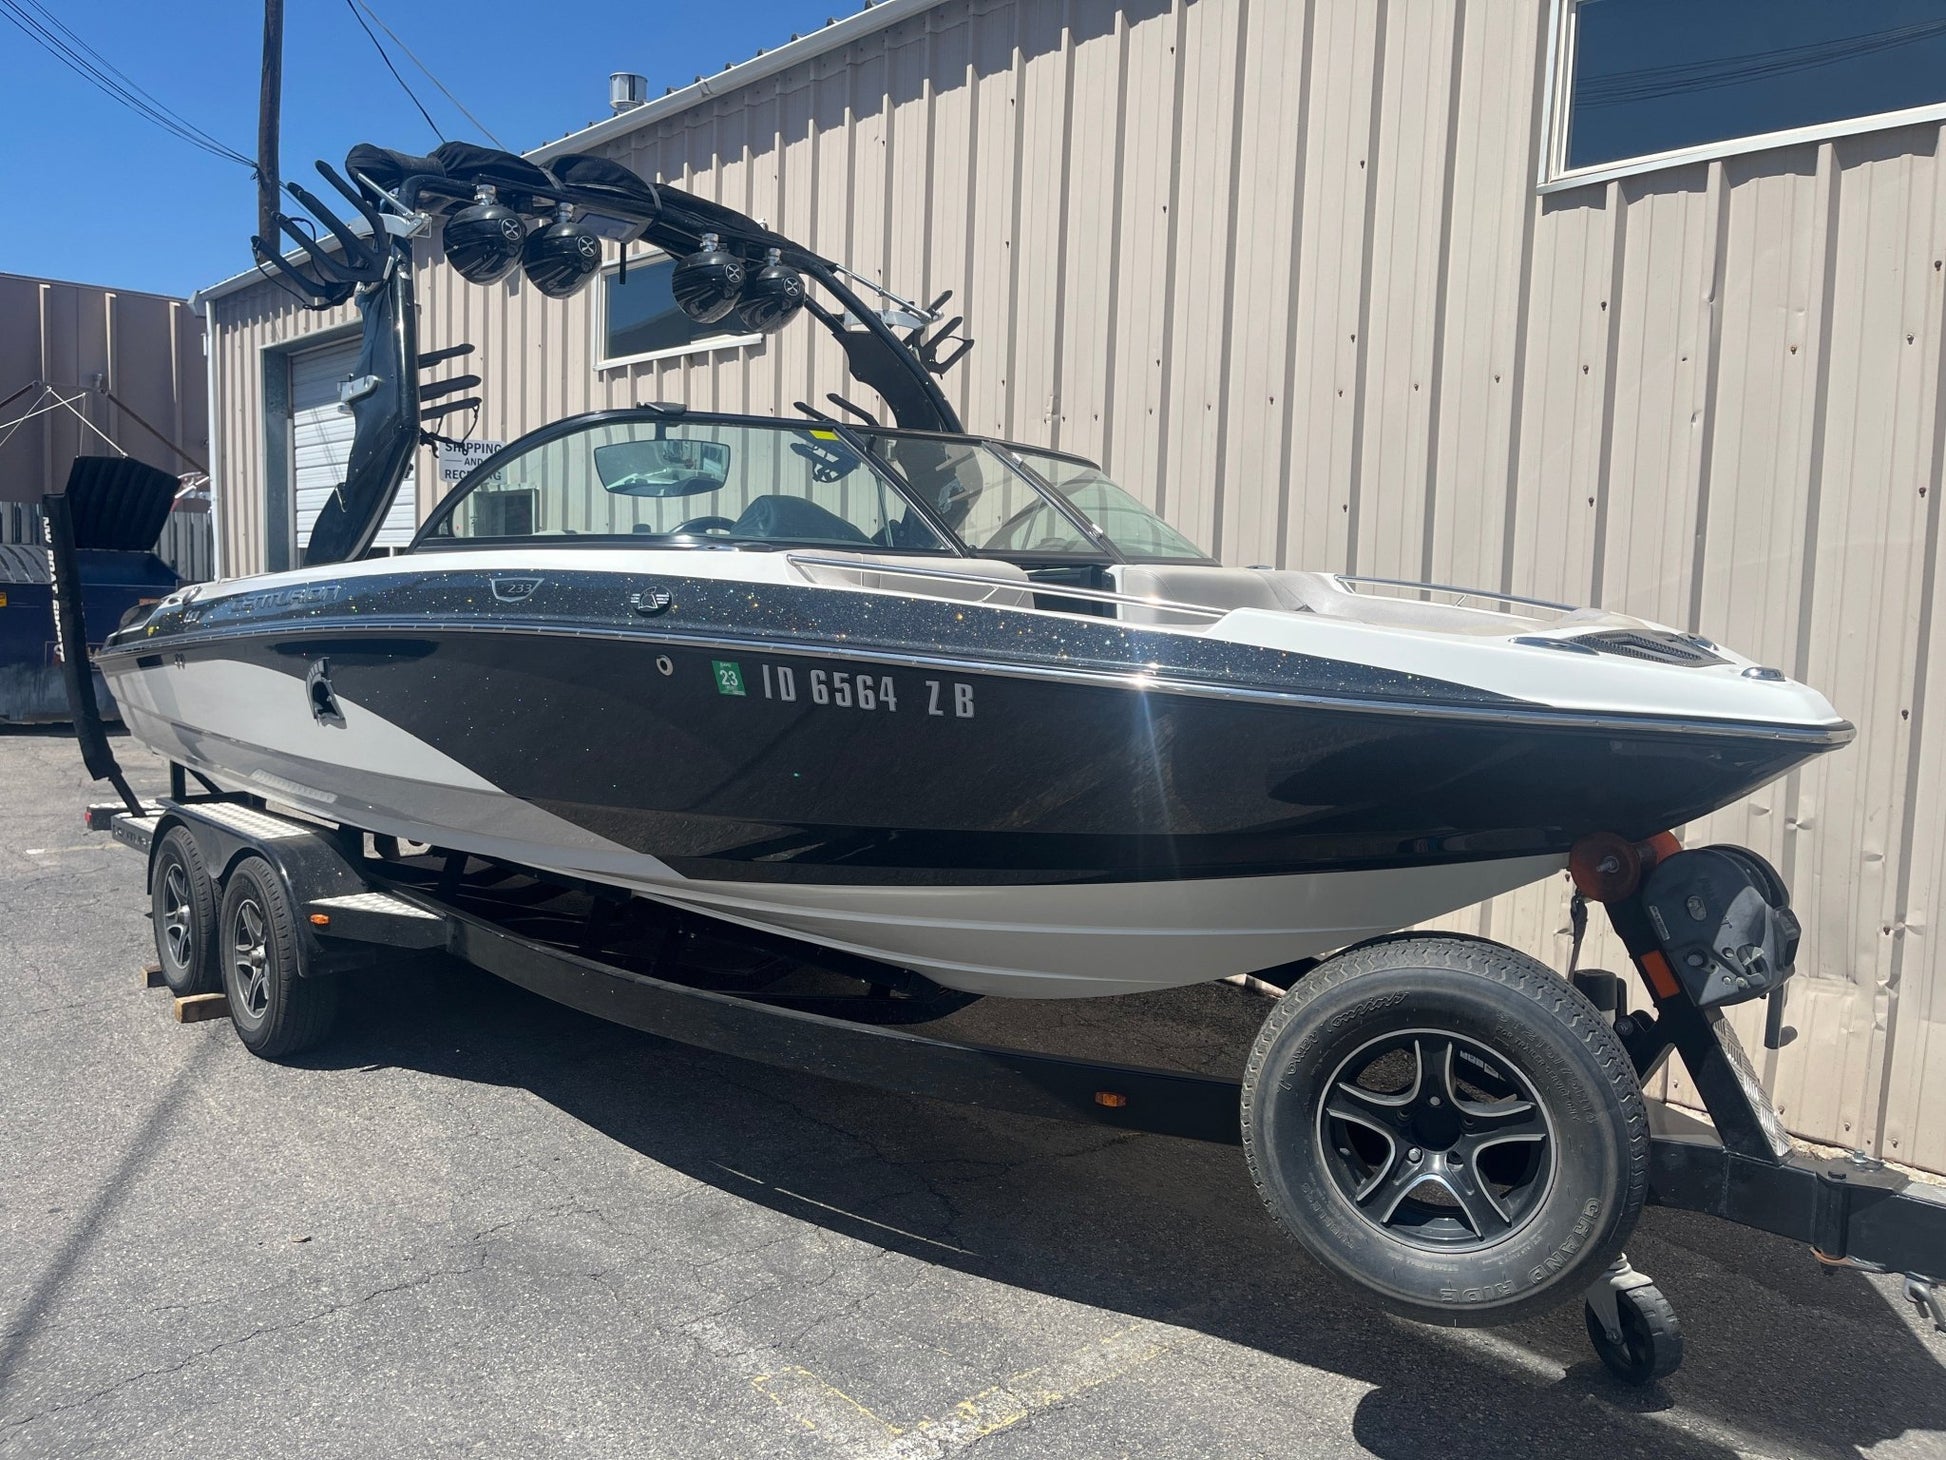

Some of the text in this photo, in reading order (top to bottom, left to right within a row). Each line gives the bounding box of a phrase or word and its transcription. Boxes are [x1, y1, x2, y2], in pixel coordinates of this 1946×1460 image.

[230, 585, 341, 612] CENTURION
[508, 584, 533, 594] 233
[720, 669, 738, 686] 23
[761, 664, 796, 702] ID
[810, 669, 898, 712] 6564
[1528, 1197, 1602, 1285] GRAND
[1440, 1279, 1518, 1303] RIDE
